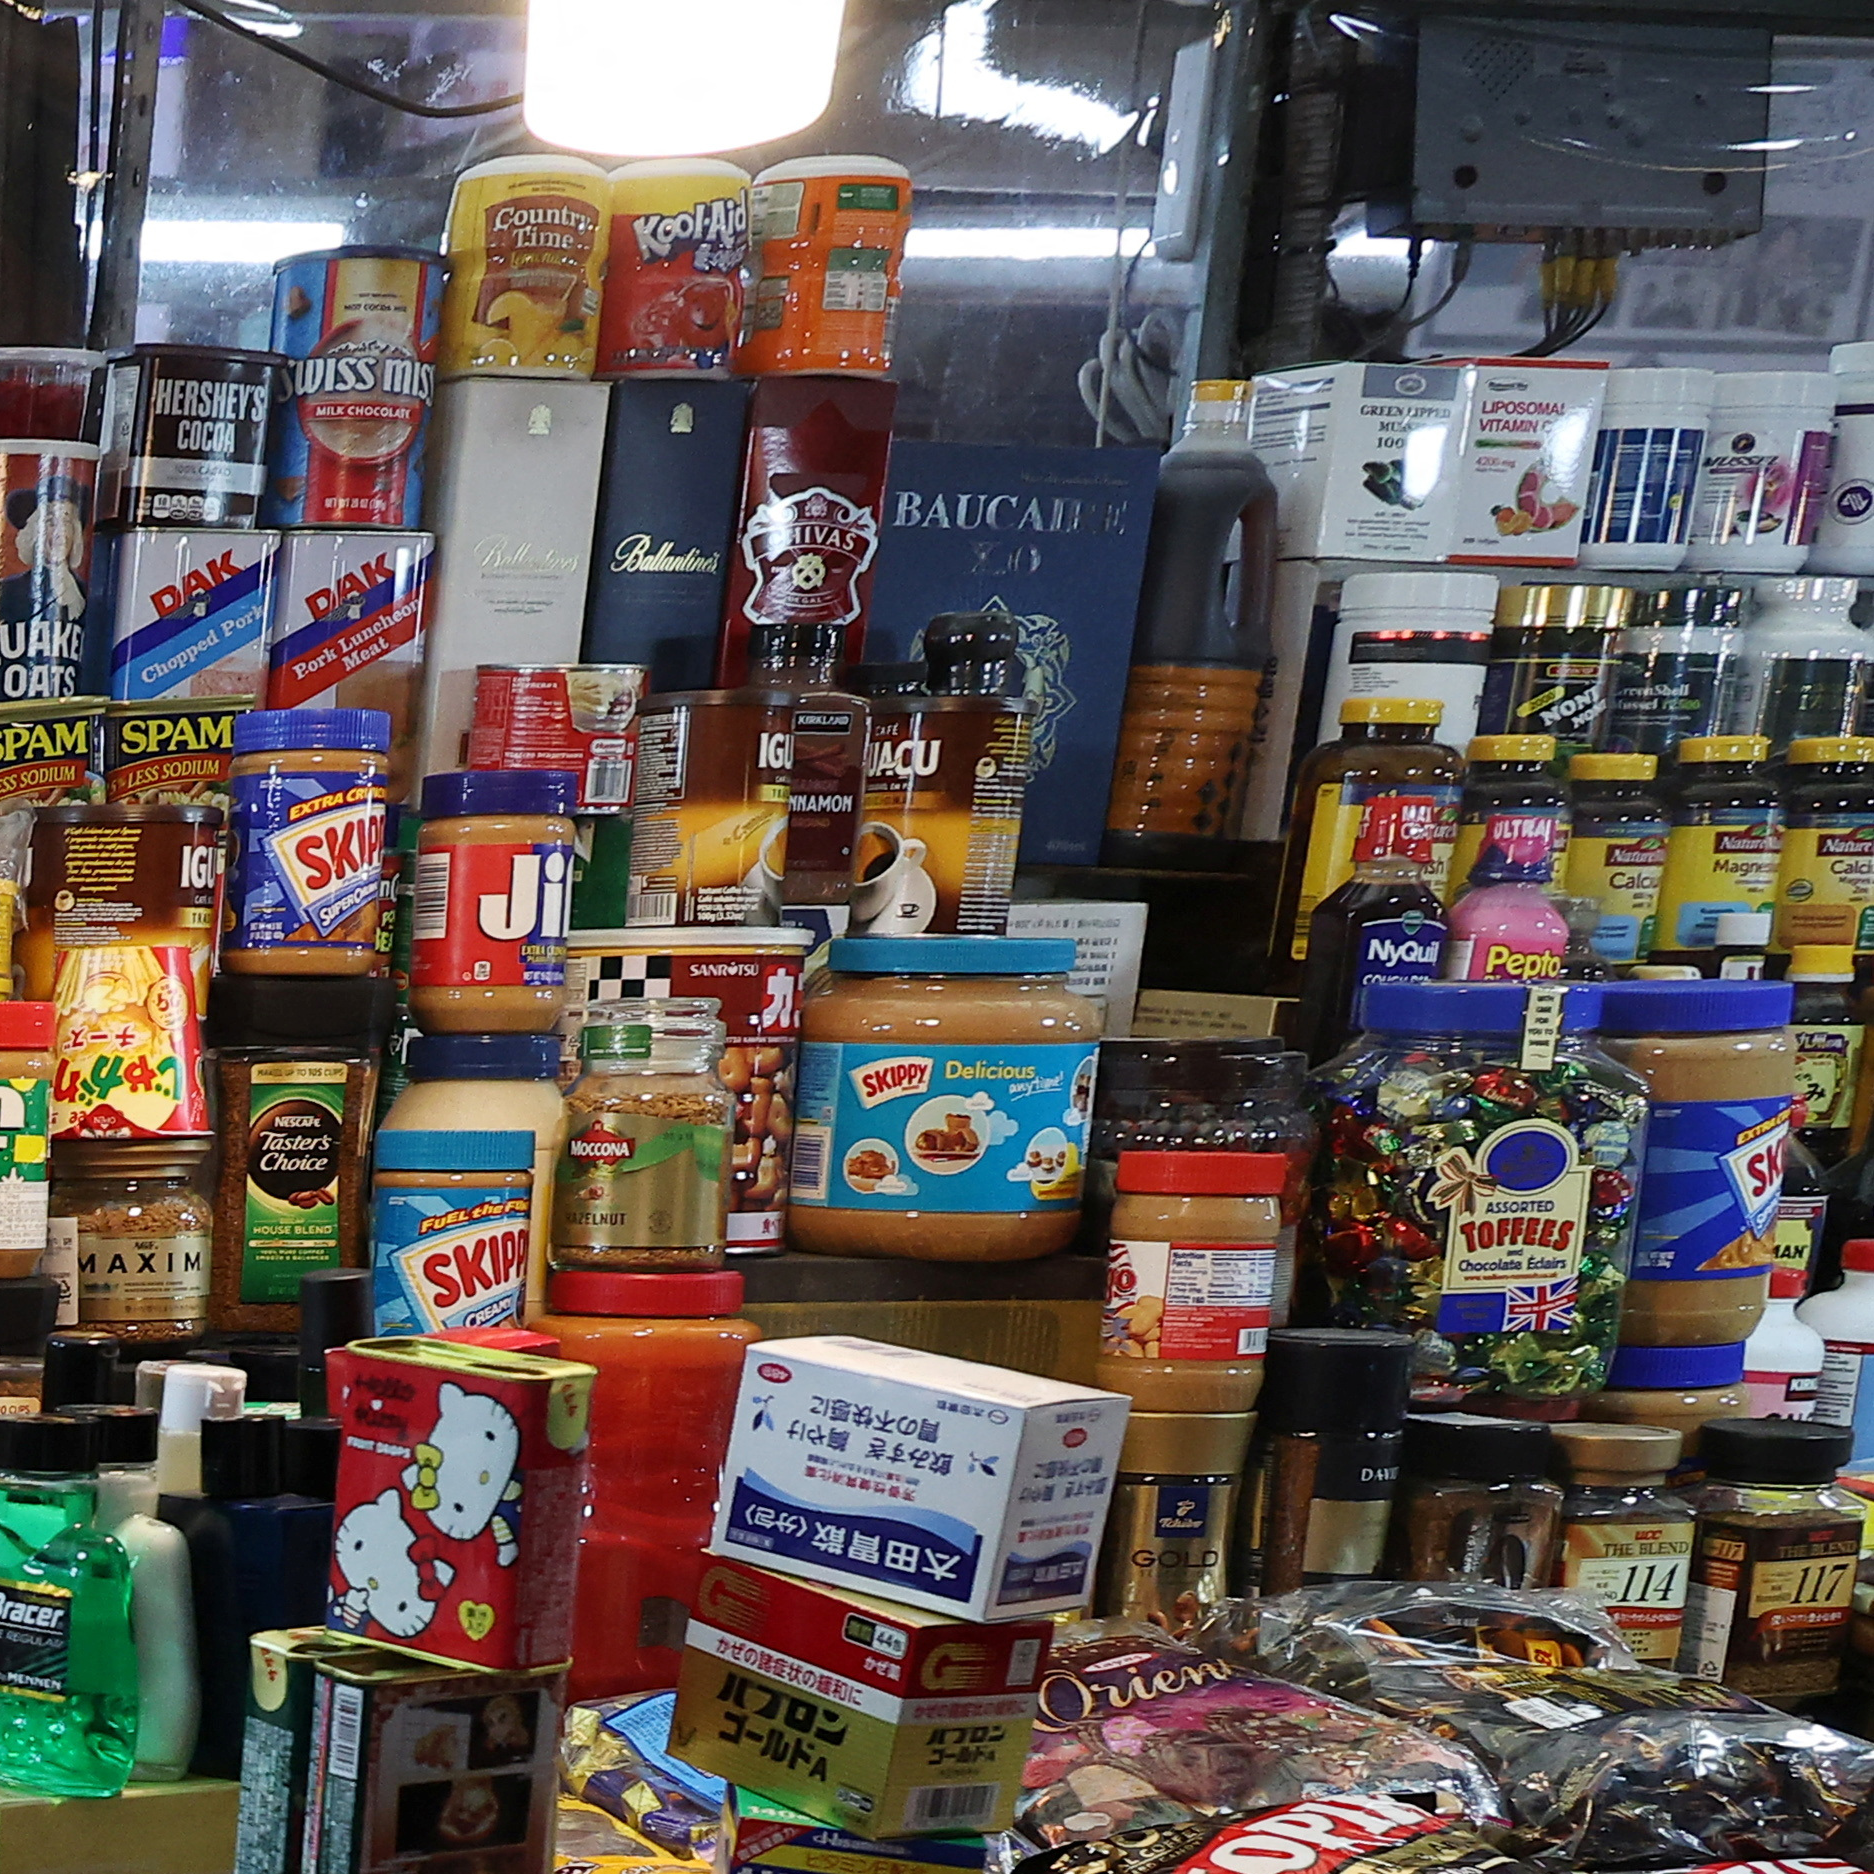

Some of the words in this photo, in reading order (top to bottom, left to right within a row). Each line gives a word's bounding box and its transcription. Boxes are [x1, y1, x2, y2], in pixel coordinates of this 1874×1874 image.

[492, 203, 587, 237] Country
[512, 226, 575, 252] Time
[154, 378, 266, 423] HERSHEY'S
[315, 404, 345, 417] MILK
[347, 404, 411, 420] CHOCOLATE
[176, 419, 237, 454] COCOA
[149, 548, 245, 618] DAK
[304, 552, 396, 622] DAK
[140, 623, 220, 685] Chopped
[219, 601, 265, 635] Pork
[291, 645, 338, 680] Pork
[336, 598, 421, 652] Luncheon
[341, 636, 390, 673] Meat
[3, 661, 77, 698] OATS
[120, 715, 234, 755] SPAM
[19, 766, 76, 791] SODIUM
[127, 767, 158, 788] LESS
[160, 758, 220, 779] SODIUM
[289, 791, 343, 822] EXTRA
[1367, 937, 1440, 968] NyQuil
[1484, 944, 1562, 977] Pepto
[858, 1061, 934, 1104] SKIPPY
[943, 1059, 1036, 1083] Delicious
[259, 1131, 332, 1152] Taster's
[570, 1139, 630, 1158] MOCCONA
[259, 1152, 328, 1172] Choice
[1485, 1199, 1555, 1215] ASSORTED
[253, 1224, 292, 1235] HOUSE
[294, 1224, 333, 1235] BLEND
[1459, 1216, 1576, 1253] TOFFEES
[78, 1250, 202, 1275] MAXIM
[1458, 1255, 1522, 1271] Chocolate
[785, 1418, 850, 1452] 胸やけ
[810, 1394, 942, 1444] 胃の不快感に
[863, 1437, 955, 1476] 飲みすぎ
[1603, 1543, 1636, 1558] THE
[1639, 1541, 1690, 1556] BLEND
[1634, 1529, 1663, 1541] UCC
[1131, 1546, 1219, 1570] GOLD
[1616, 1561, 1681, 1602] 114
[1788, 1562, 1850, 1604] 117
[7, 1671, 62, 1691] MENNEN
[716, 1633, 864, 1707] かぜの諸症状の緩和に
[716, 1670, 849, 1748] パブロン
[718, 1710, 829, 1783] ゴールドA
